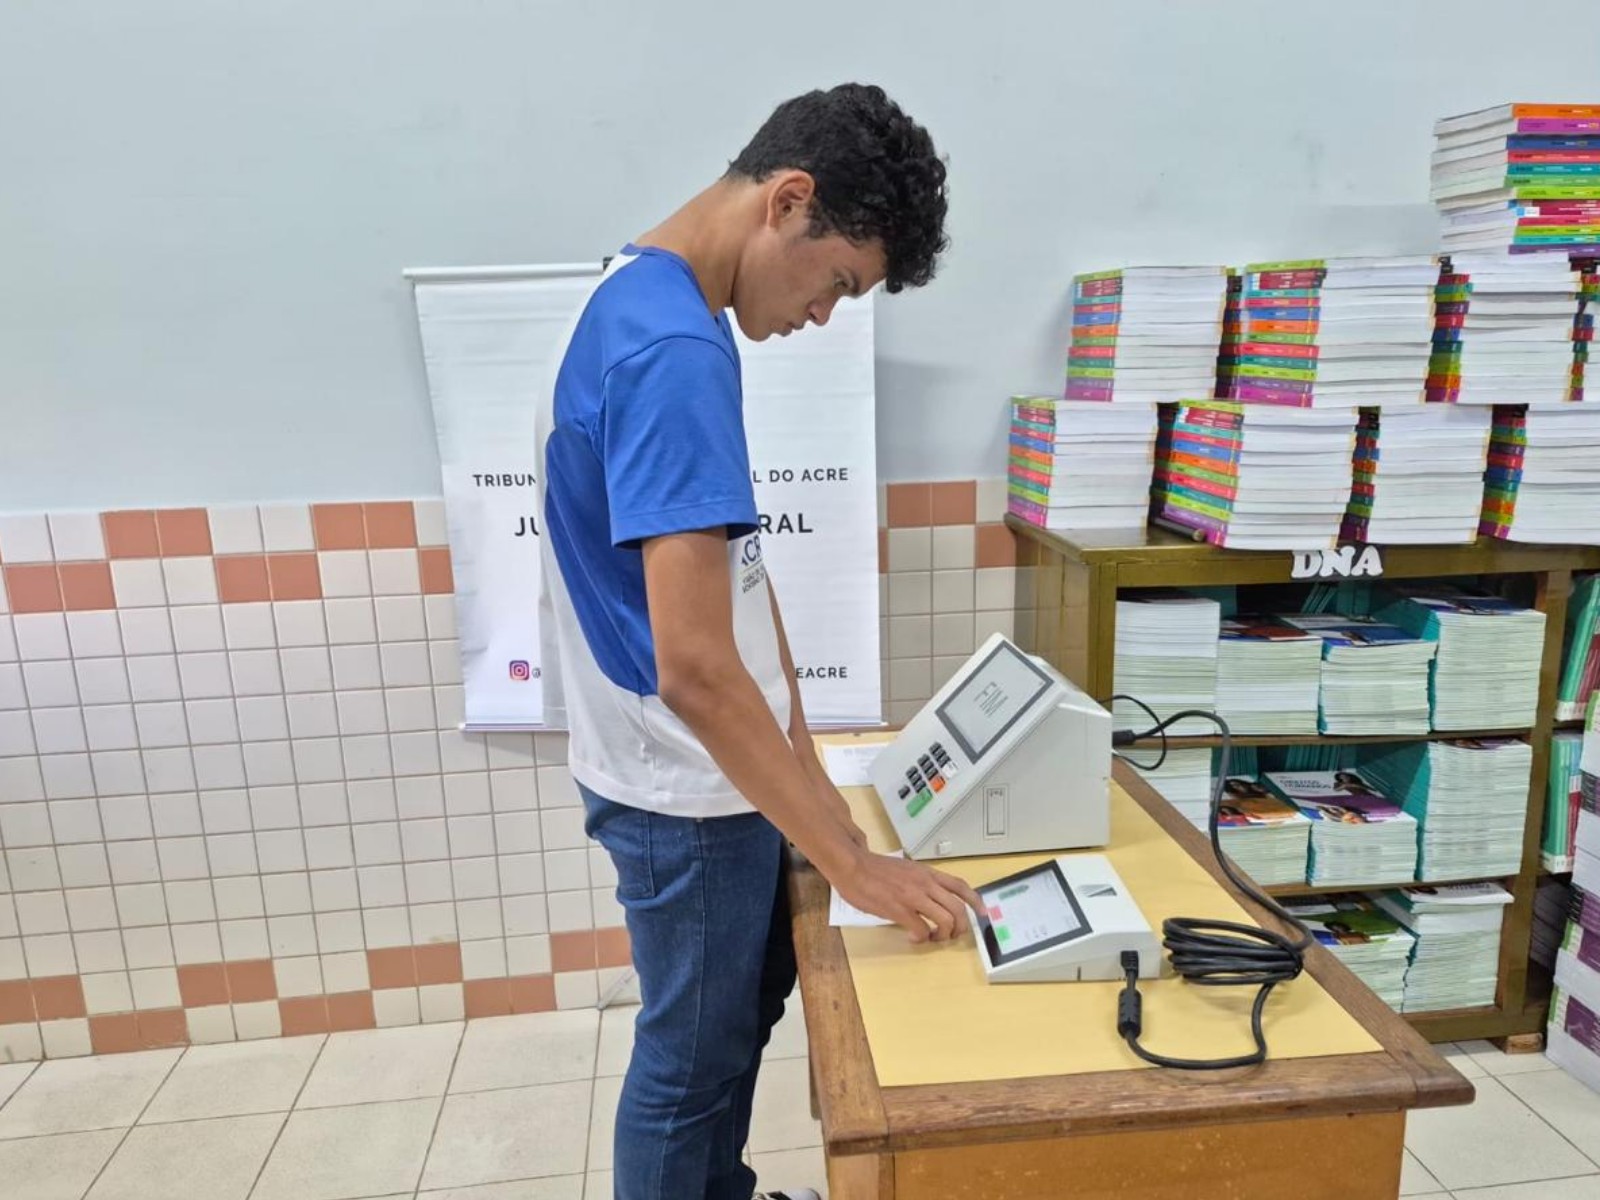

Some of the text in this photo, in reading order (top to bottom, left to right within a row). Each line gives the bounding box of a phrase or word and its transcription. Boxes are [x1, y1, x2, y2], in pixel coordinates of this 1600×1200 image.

[769, 469, 794, 483] DO
[801, 467, 848, 482] ACRE
[757, 512, 814, 535] RAL
[1291, 545, 1383, 579] DNA
[795, 666, 848, 679] EACRE
